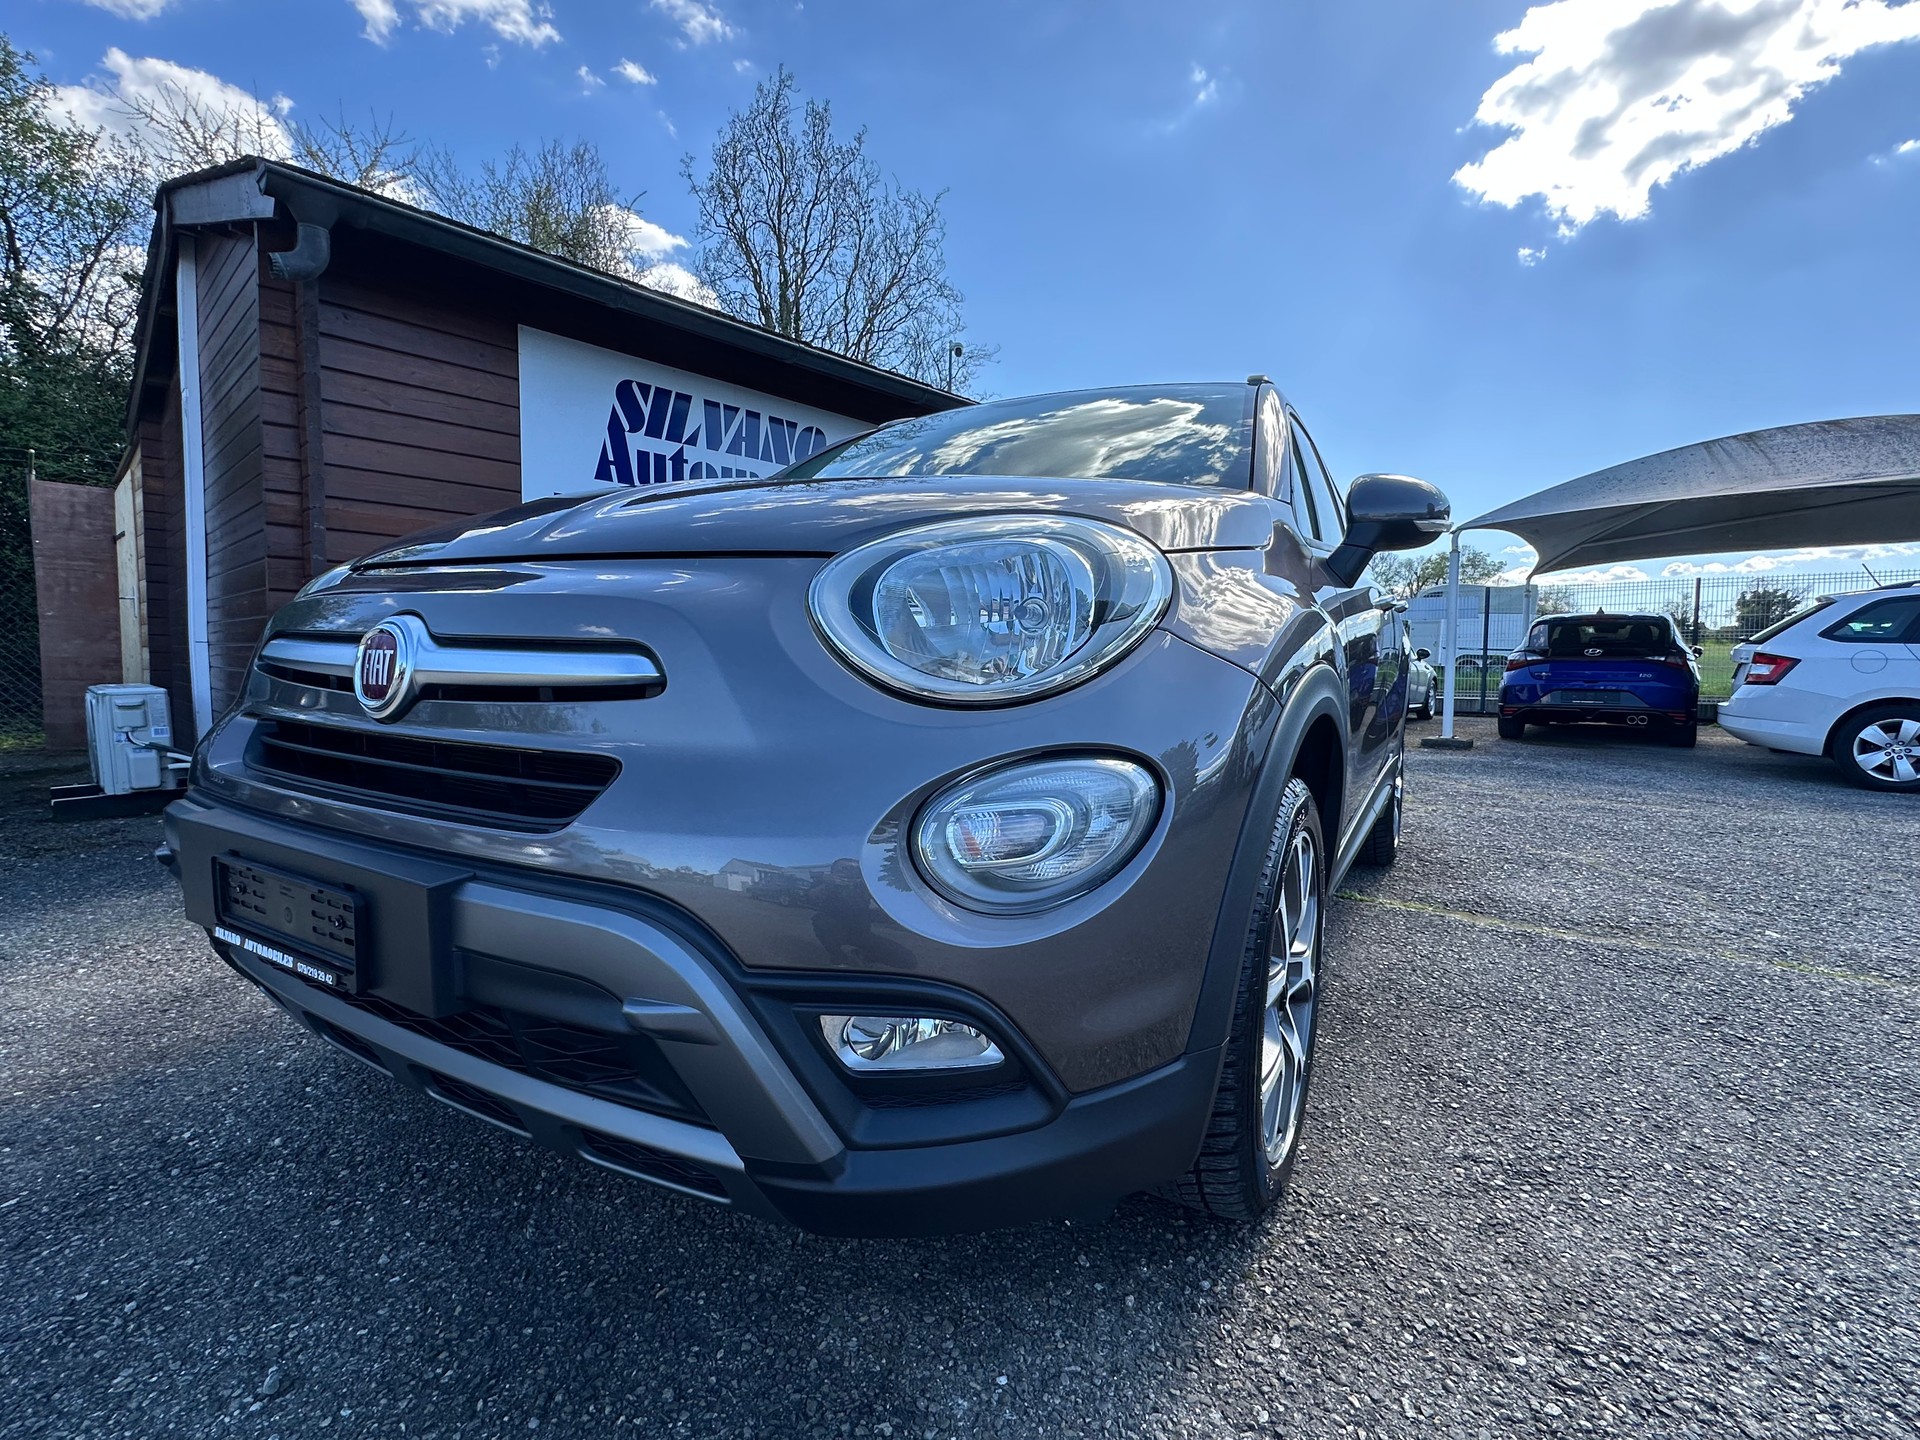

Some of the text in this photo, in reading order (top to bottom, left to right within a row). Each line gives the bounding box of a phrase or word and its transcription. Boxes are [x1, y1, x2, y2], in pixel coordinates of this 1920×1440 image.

[615, 379, 827, 466] SILVANO
[363, 649, 394, 685] FIAT
[243, 938, 294, 968] AUTOMOBILES
